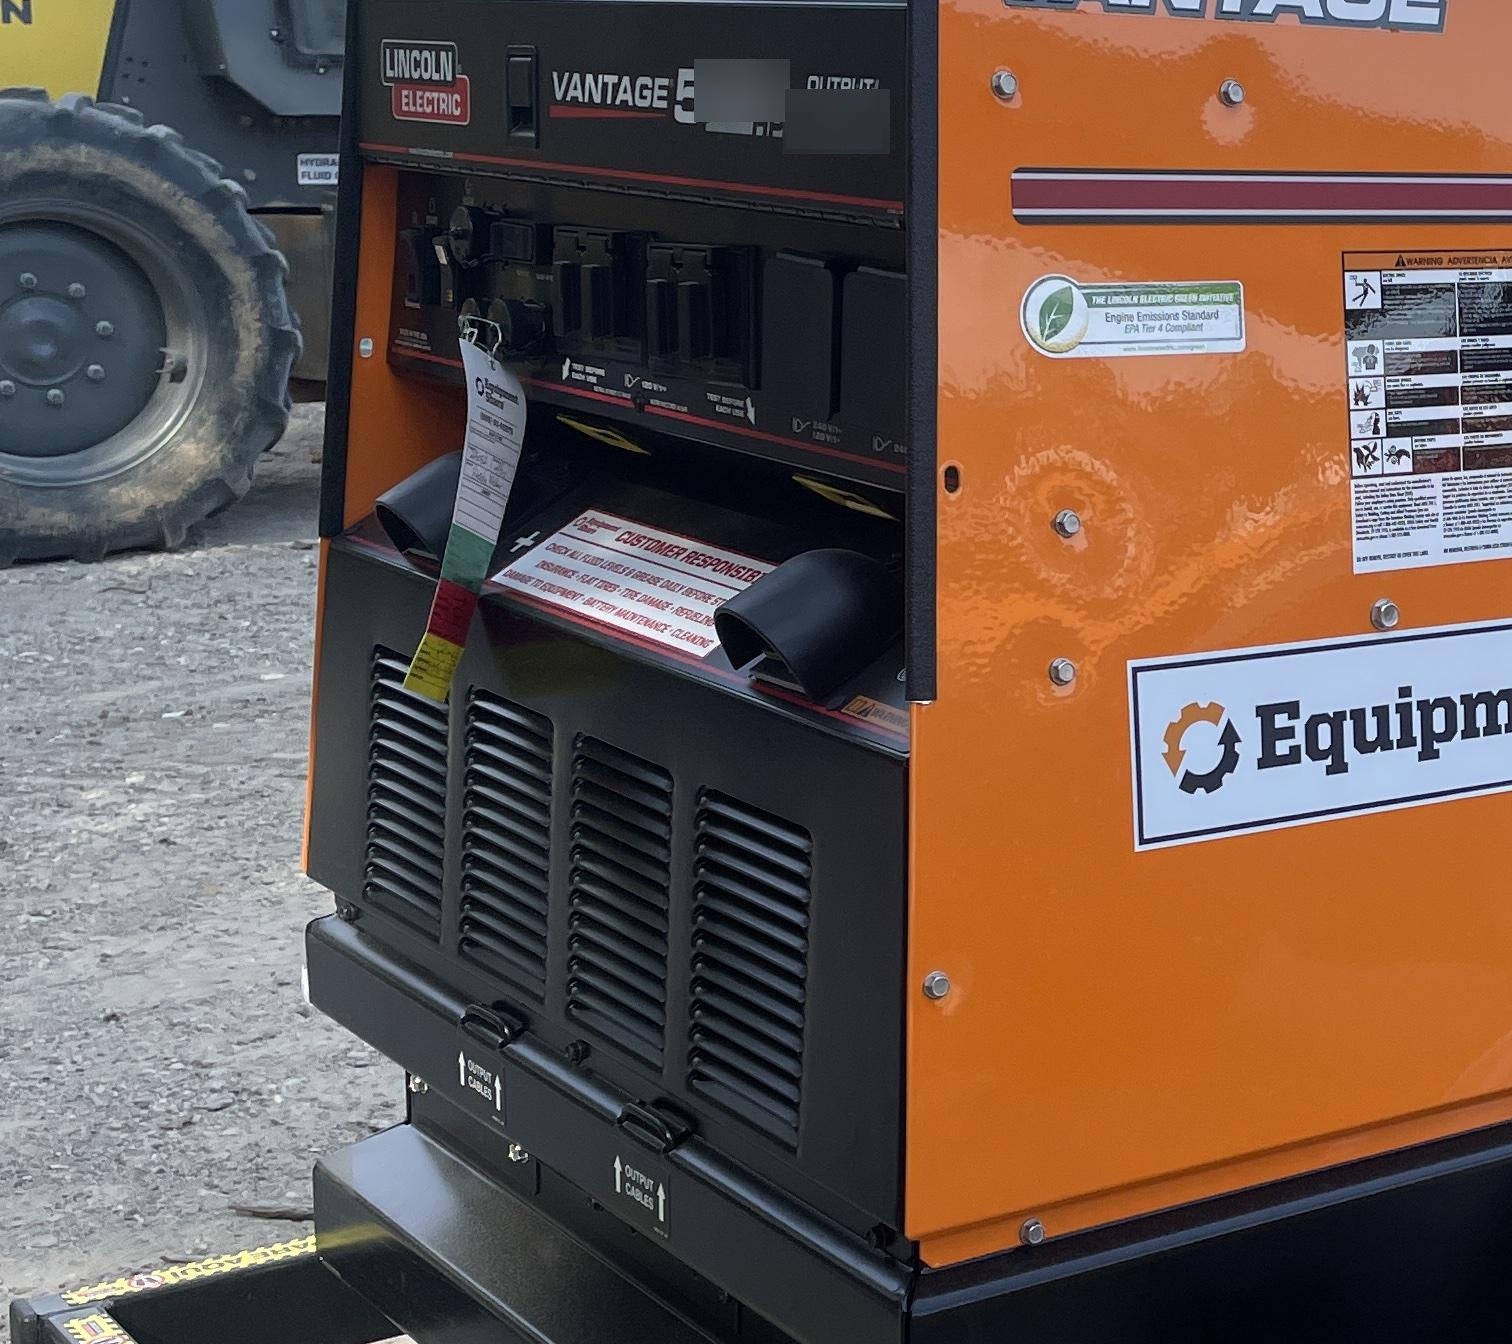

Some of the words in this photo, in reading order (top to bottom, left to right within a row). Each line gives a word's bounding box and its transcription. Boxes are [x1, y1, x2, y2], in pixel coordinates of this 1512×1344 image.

[386, 48, 453, 82] LINCOLN
[401, 89, 461, 116] ELECTRIC
[552, 71, 670, 109] VANTAGE
[301, 171, 332, 180] FLUID
[1406, 257, 1443, 266] WARNING
[1448, 256, 1497, 265] ADVERTENCIA
[1092, 295, 1106, 305] THE
[1107, 295, 1138, 305] LINCOLN
[1140, 294, 1173, 304] ELECTRIC
[1105, 312, 1134, 324] Engine
[1137, 311, 1179, 322] Emissions
[1182, 309, 1219, 320] Standard
[1124, 324, 1139, 334] EPA
[1142, 324, 1156, 333] Tier
[1165, 323, 1203, 334] Compliant
[615, 531, 686, 558] CUSTOMER
[545, 543, 570, 554] CHECK
[565, 550, 584, 559] ALL
[579, 554, 603, 565] FLUID
[599, 561, 628, 573] LEVELS
[631, 571, 662, 584] GREASE
[659, 580, 684, 592] DAILY
[681, 587, 713, 602] BEFORE
[576, 574, 597, 584] FLAT
[594, 580, 618, 591] TIRES
[619, 588, 640, 599] TIRE
[637, 594, 671, 610] DAMAGE
[503, 569, 533, 582] DAMAGE
[529, 579, 544, 587] TO
[539, 582, 583, 601] EQUIPMENT
[582, 598, 616, 613] BATTERY
[613, 609, 669, 632] MAINTENANCE
[670, 629, 711, 648] CLEANING
[467, 1059, 493, 1083] OUTPUT
[468, 1075, 493, 1102] CABLES
[624, 1164, 654, 1193] OUTPUT
[625, 1182, 654, 1212] CABLES
